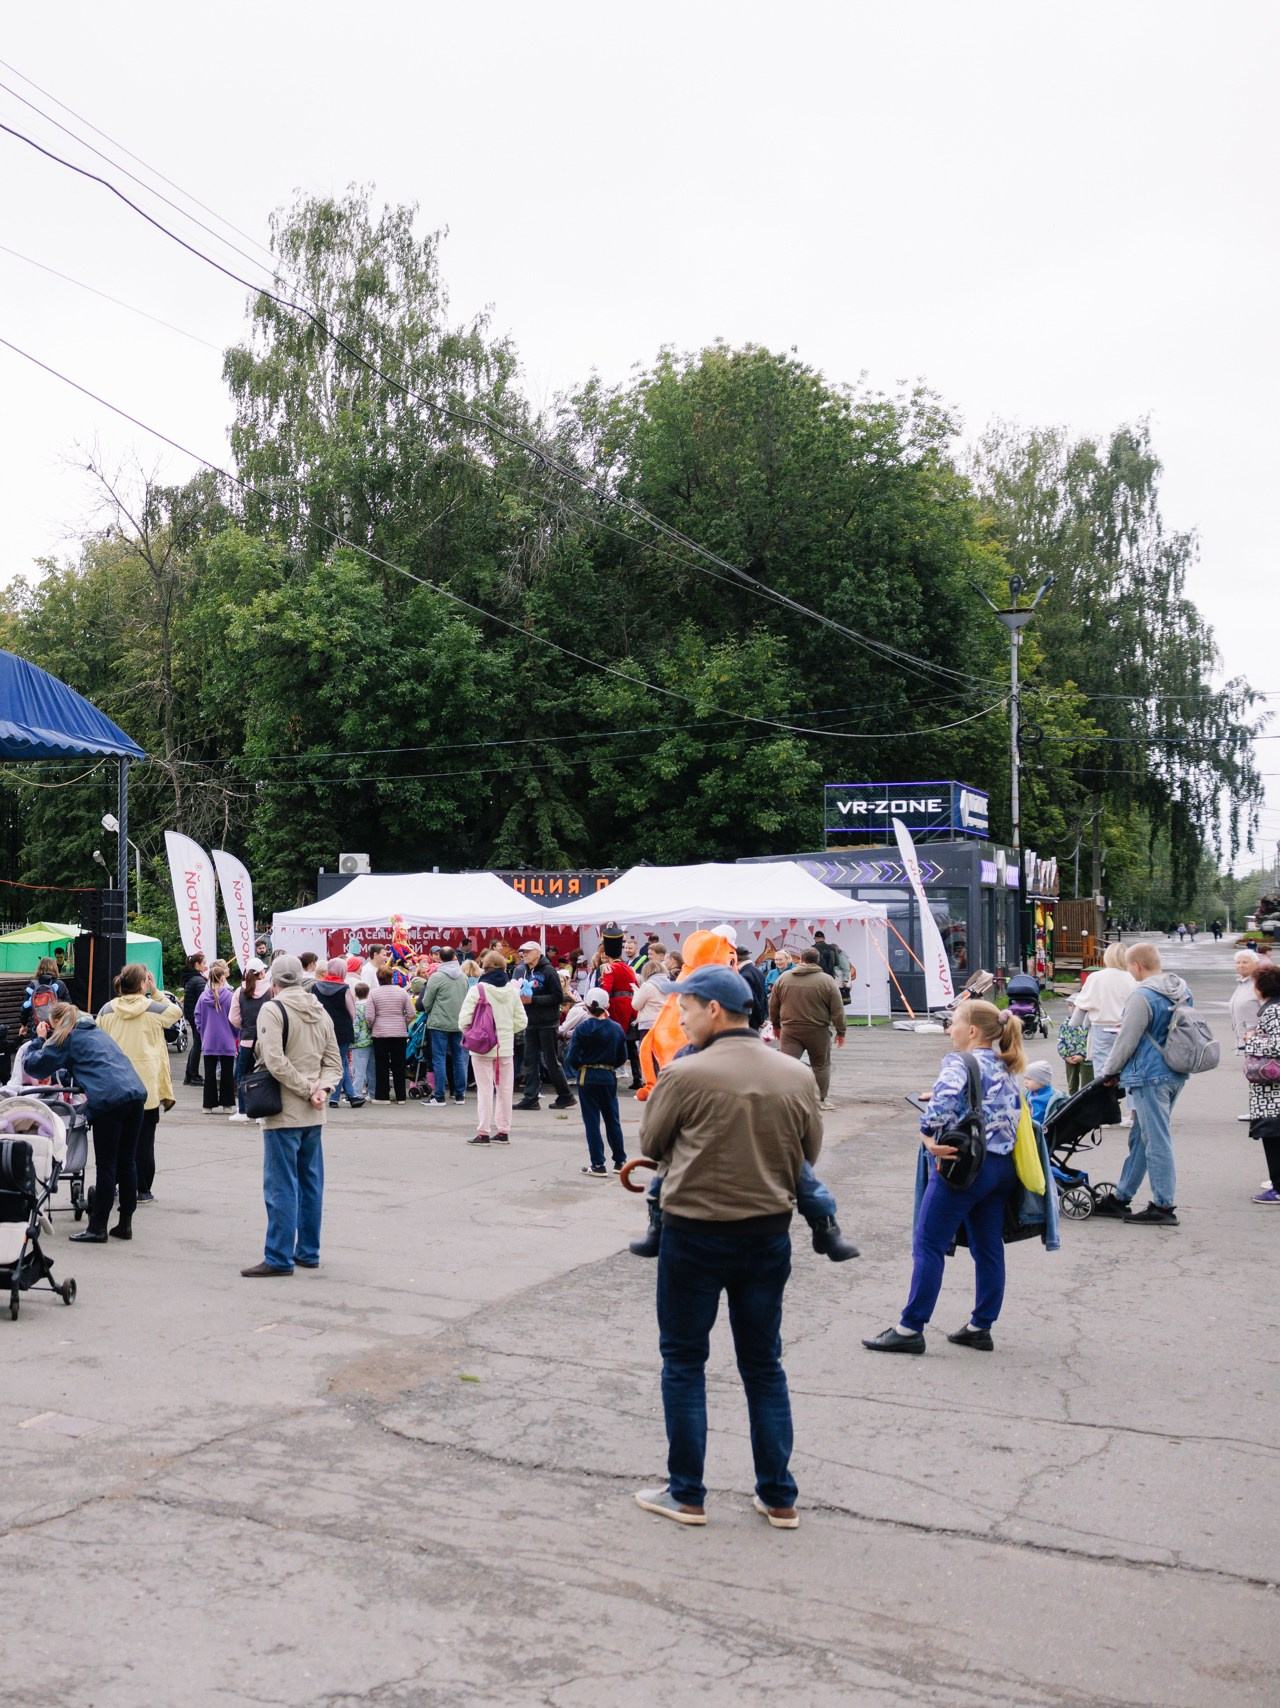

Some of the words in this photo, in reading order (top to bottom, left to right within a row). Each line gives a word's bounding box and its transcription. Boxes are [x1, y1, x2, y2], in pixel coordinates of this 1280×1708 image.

[837, 799, 942, 814] VR-ZONE
[512, 878, 581, 896] НЦИЯ
[344, 931, 364, 941] ГОД
[365, 931, 392, 940] СЕМЬ
[408, 930, 440, 940] МЕСТЕ
